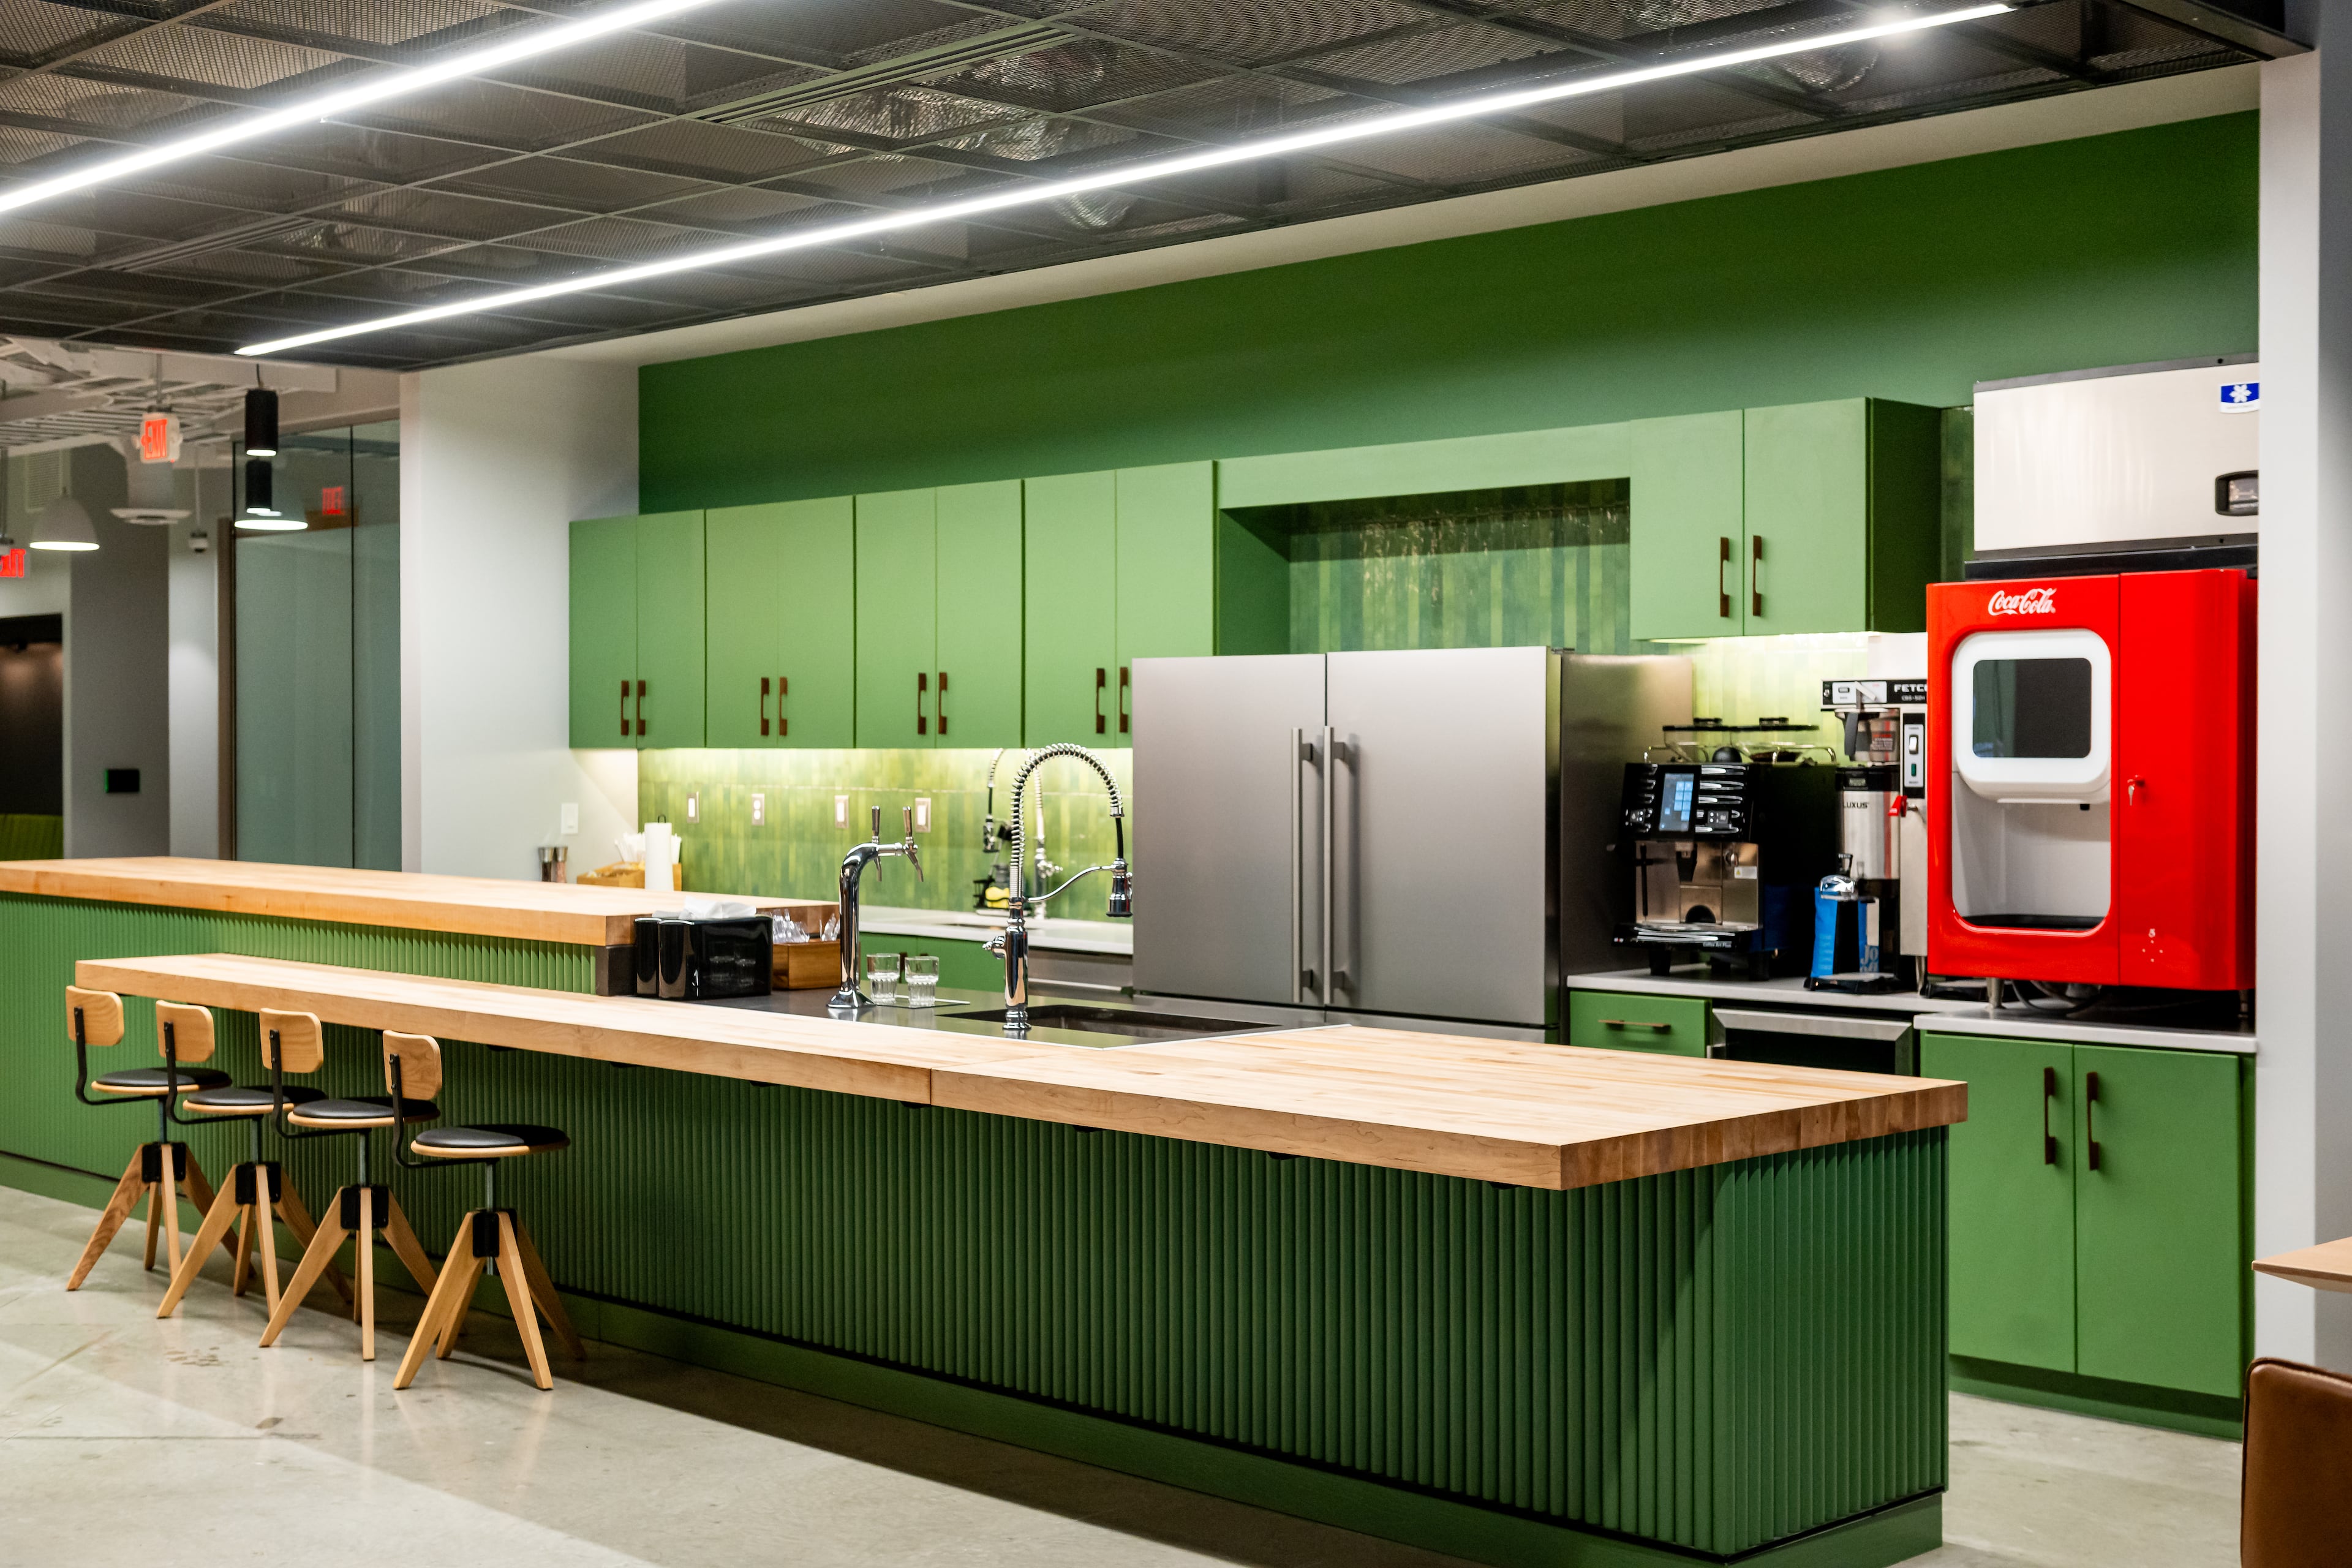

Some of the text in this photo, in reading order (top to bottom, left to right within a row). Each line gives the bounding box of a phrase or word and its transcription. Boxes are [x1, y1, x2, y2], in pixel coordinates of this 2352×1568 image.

[145, 419, 167, 459] EXIT
[0, 548, 26, 577] XIT
[1988, 588, 2057, 616] Coca-Cola
